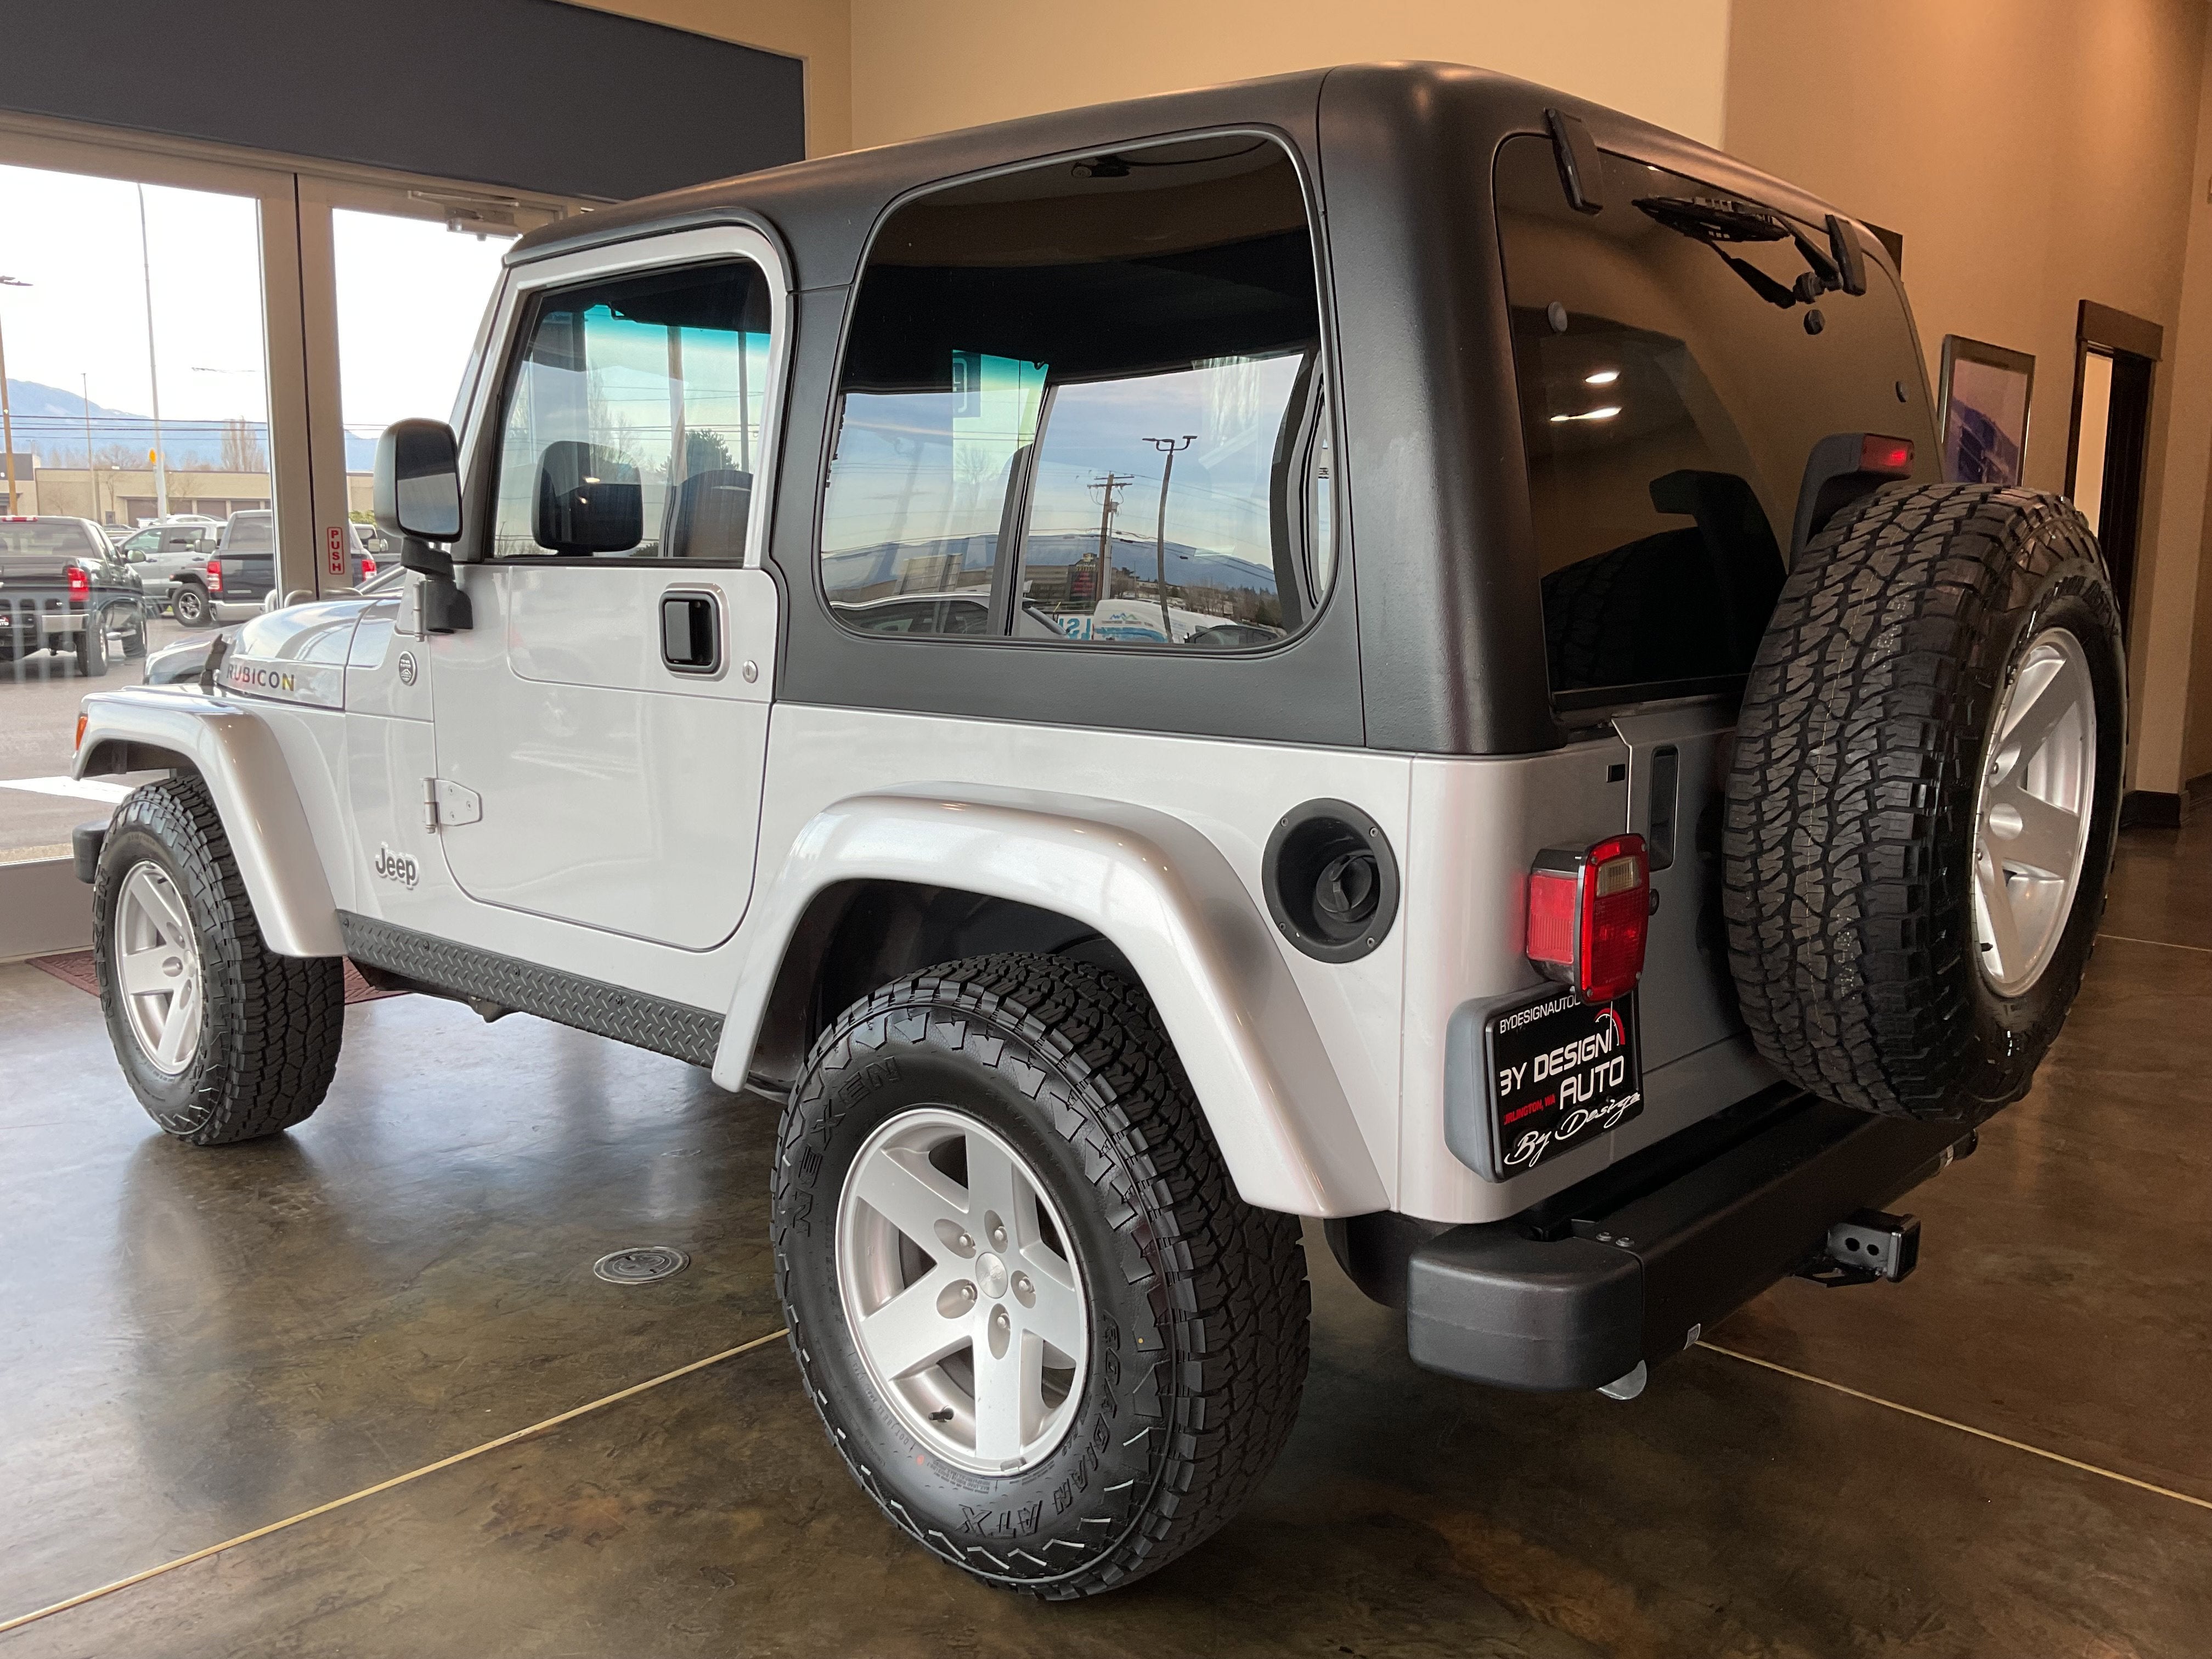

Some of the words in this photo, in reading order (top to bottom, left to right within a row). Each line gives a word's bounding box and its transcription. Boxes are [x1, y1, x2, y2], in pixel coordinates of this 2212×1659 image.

[331, 529, 341, 571] PUSH
[226, 664, 295, 691] RUBICON
[375, 846, 417, 887] Jeep
[1500, 1062, 1527, 1096] BY
[1534, 1029, 1610, 1082] DESIGN
[1560, 1056, 1624, 1110] AUTO
[1544, 1093, 1556, 1107] WA
[1504, 1131, 1552, 1167] By
[1554, 1092, 1640, 1140] Design
[955, 1500, 1043, 1537] ATX
